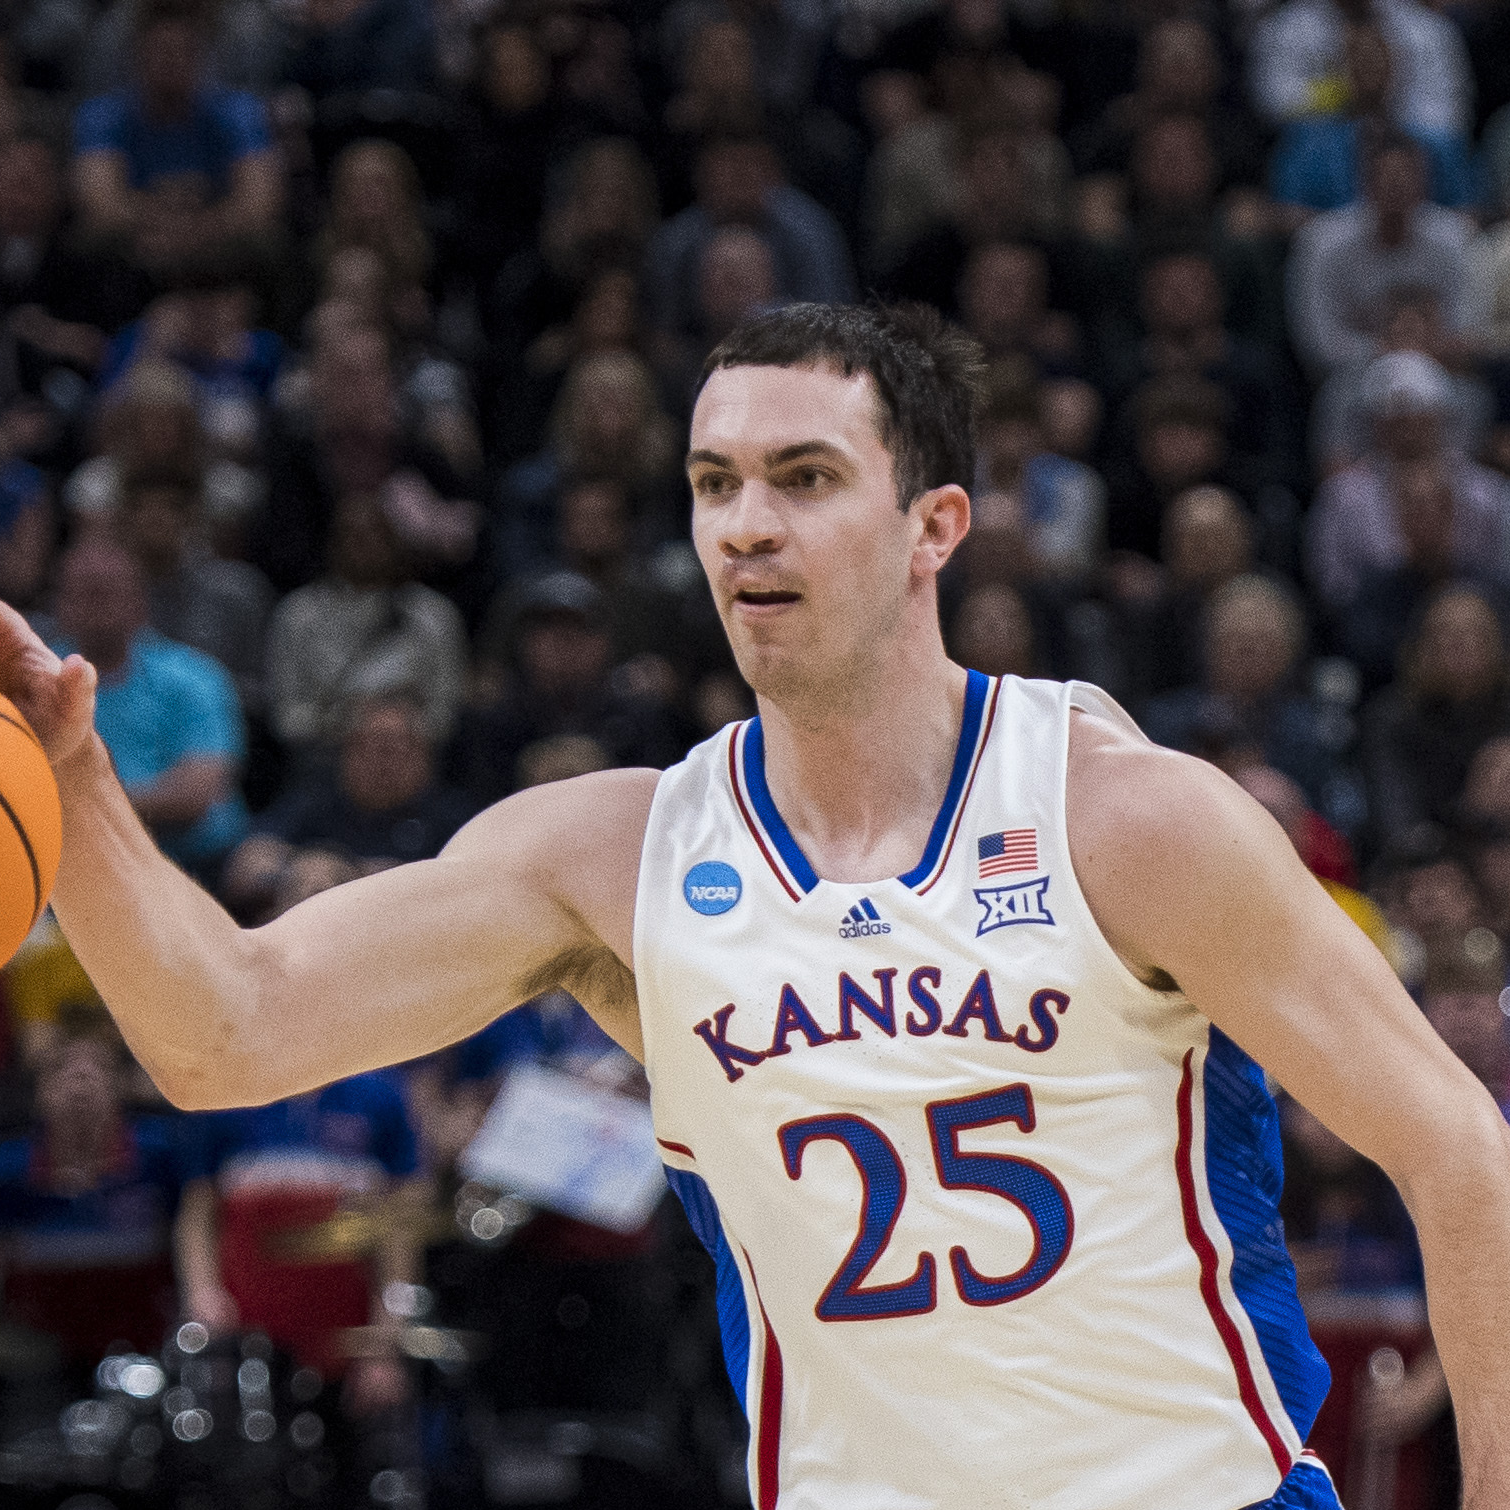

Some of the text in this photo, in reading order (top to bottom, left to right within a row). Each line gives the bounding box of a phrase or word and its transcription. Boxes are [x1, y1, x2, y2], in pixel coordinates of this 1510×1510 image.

[690, 885, 738, 901] NCAA
[839, 920, 891, 939] adidas
[693, 966, 1070, 1083] KANSAS
[777, 1082, 1075, 1323] 25
